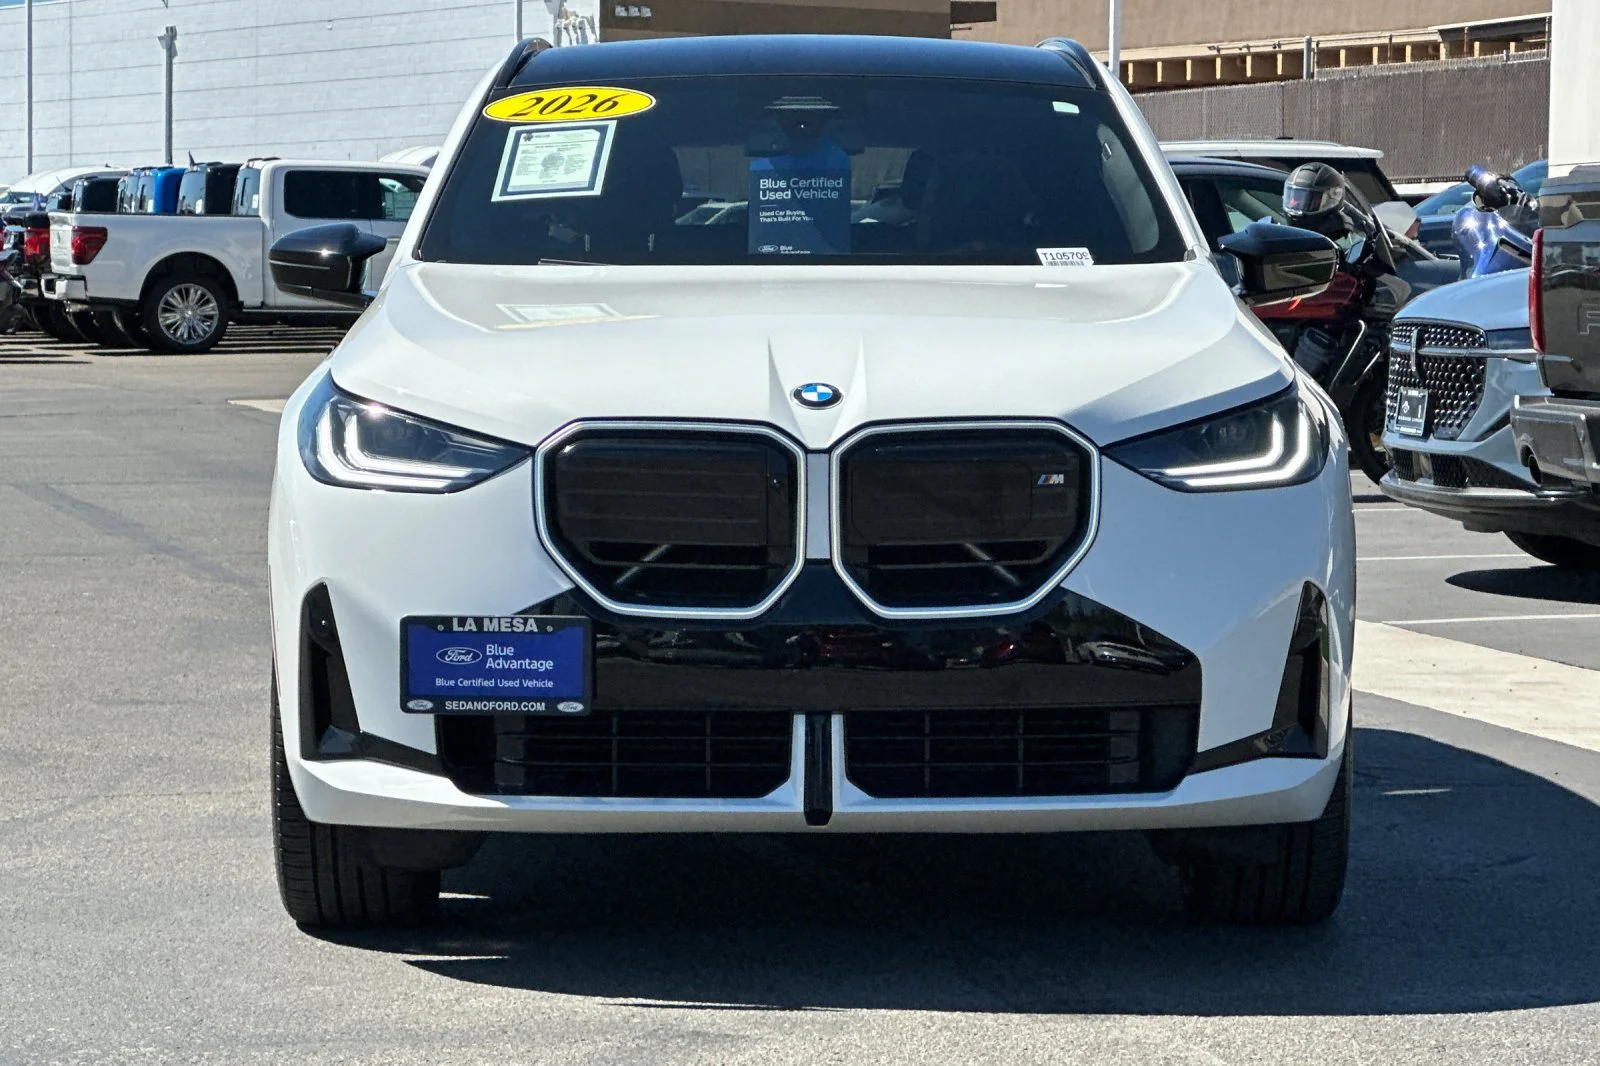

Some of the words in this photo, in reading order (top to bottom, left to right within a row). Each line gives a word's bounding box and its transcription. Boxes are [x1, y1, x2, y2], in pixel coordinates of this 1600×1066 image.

[508, 93, 630, 118] 2026
[760, 178, 787, 189] Blue
[790, 177, 843, 188] Certified
[760, 189, 791, 200] Used
[794, 189, 839, 199] Vehicle
[452, 617, 477, 632] LA
[483, 617, 539, 633] MESA
[444, 649, 473, 662] Ford
[485, 644, 514, 656] Blue
[485, 658, 554, 672] Advantage
[435, 677, 456, 687] Blue
[457, 677, 495, 687] Certified
[497, 678, 520, 688] Used
[522, 678, 554, 688] Vehicle
[445, 701, 546, 712] SEDANOFORD.COM
